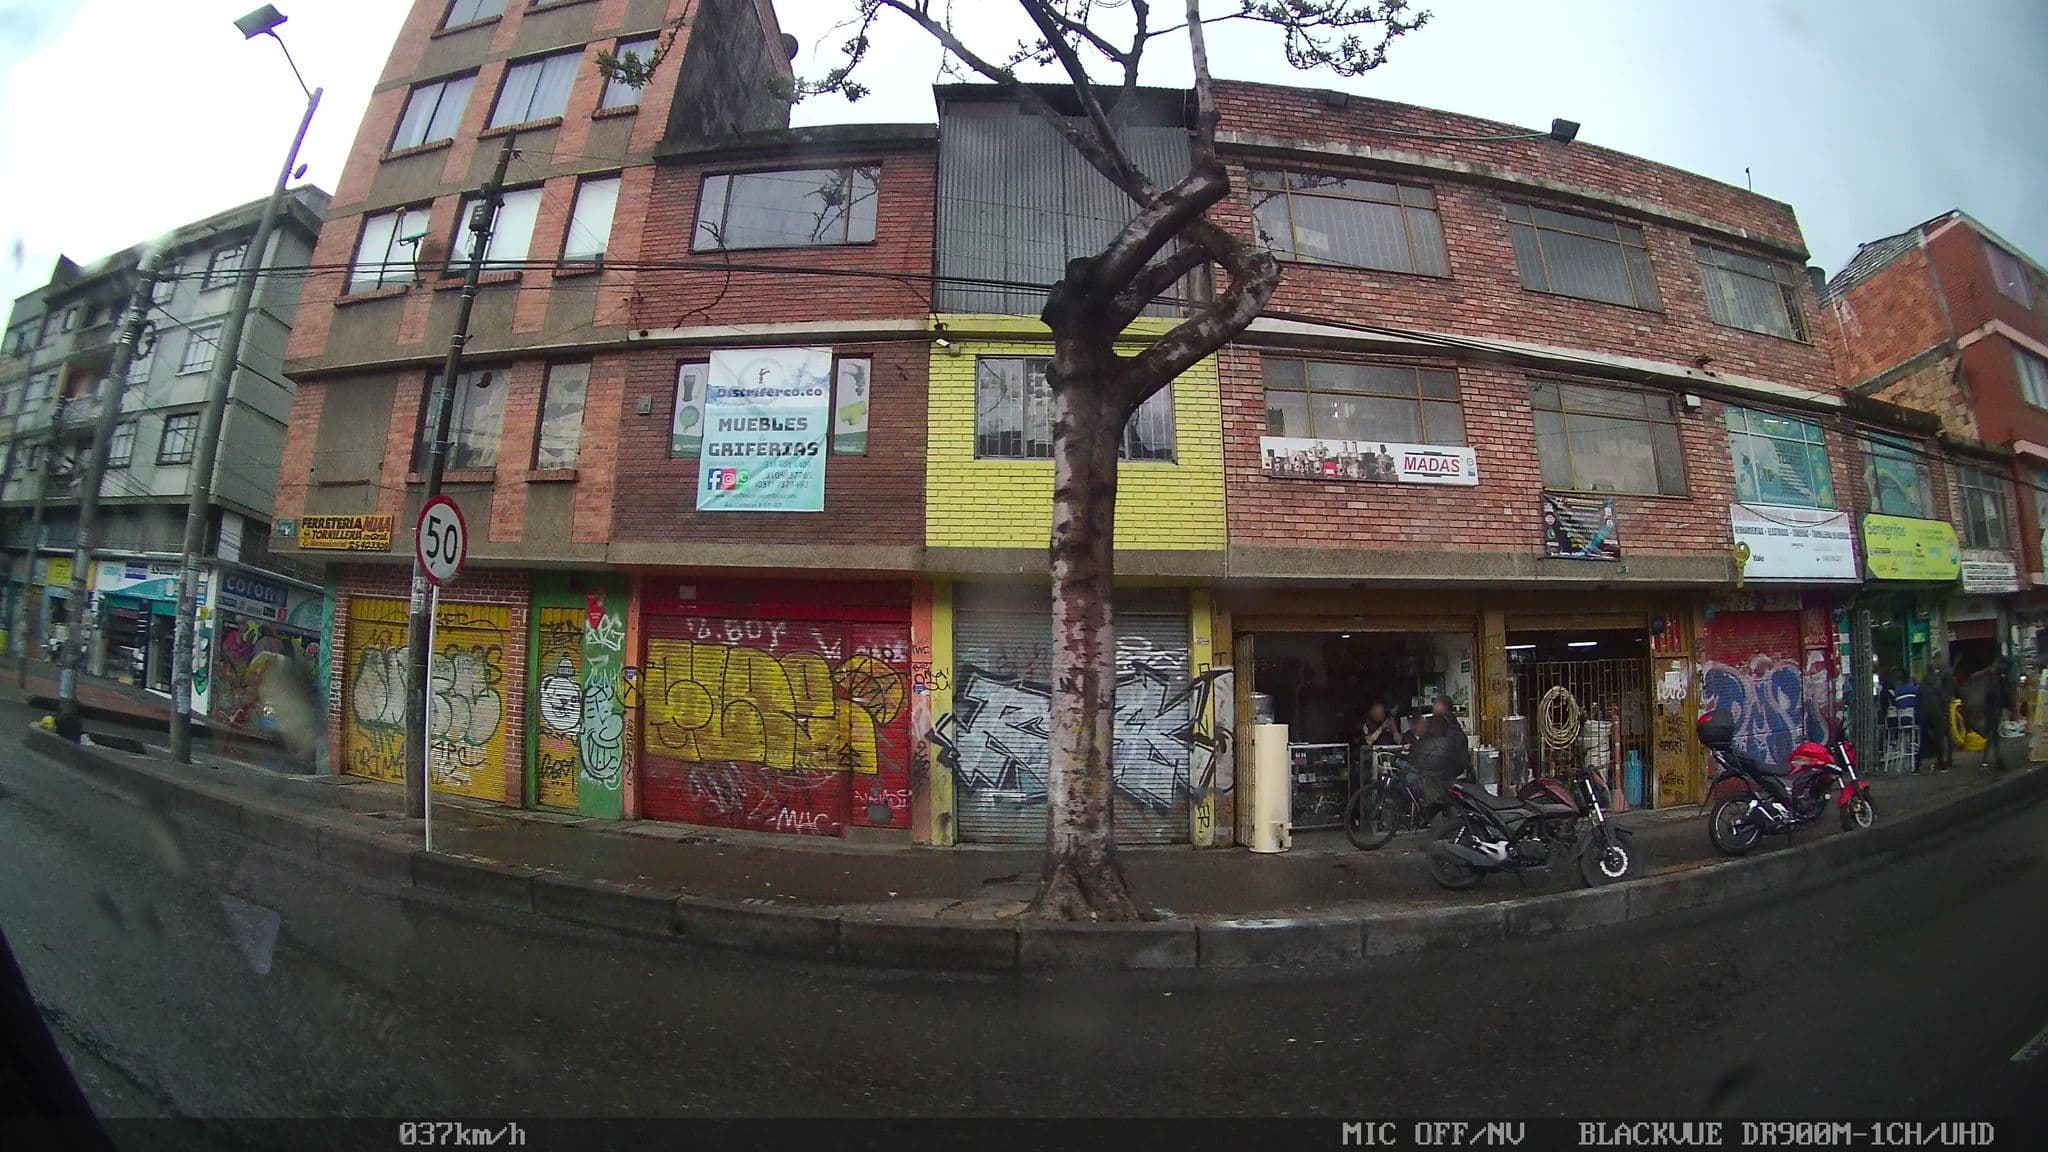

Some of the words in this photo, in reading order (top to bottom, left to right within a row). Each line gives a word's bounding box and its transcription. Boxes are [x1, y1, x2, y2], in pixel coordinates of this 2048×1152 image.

[718, 416, 808, 433] MUEBLES
[708, 441, 819, 457] GRIFERIAS
[1404, 456, 1460, 473] MADAS
[302, 516, 363, 530] FERRETERIA
[425, 514, 458, 565] 50
